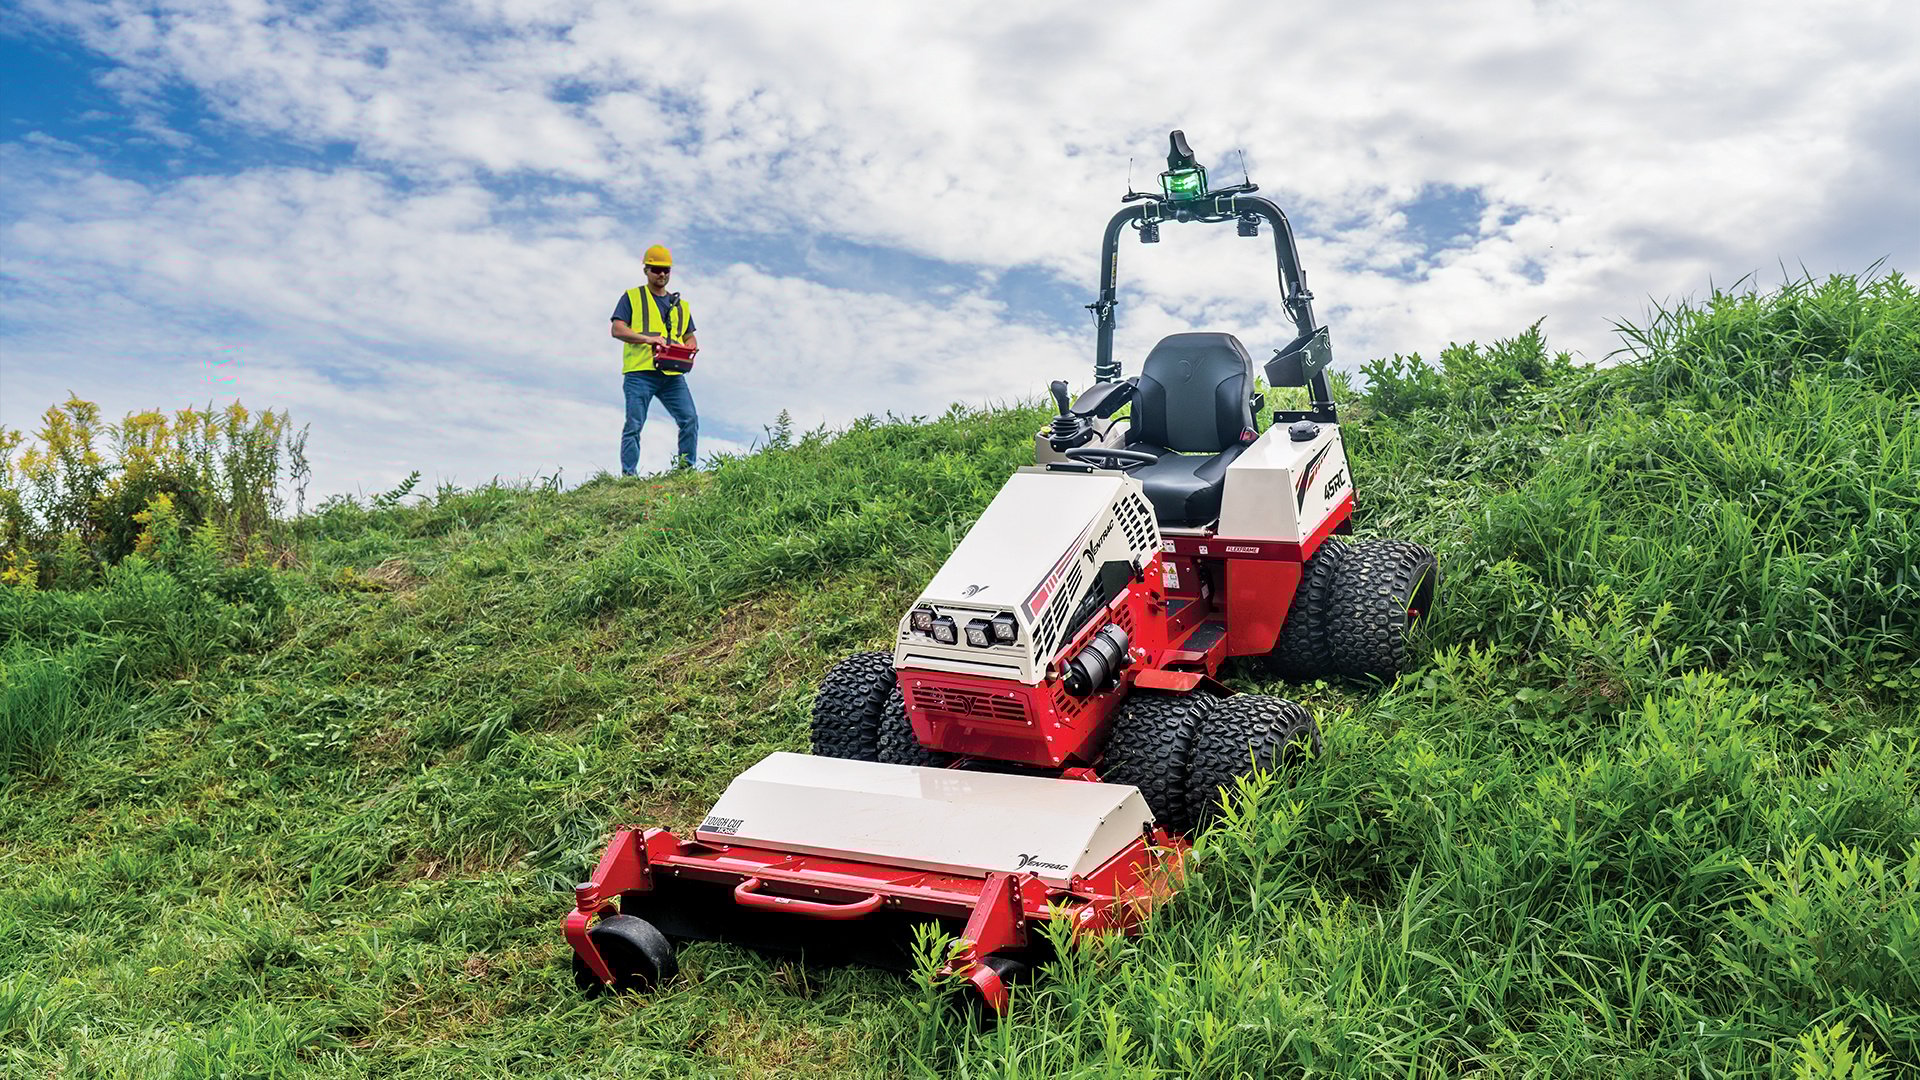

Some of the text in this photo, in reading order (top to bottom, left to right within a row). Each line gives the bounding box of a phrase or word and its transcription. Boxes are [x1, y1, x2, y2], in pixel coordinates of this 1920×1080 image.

[1324, 468, 1346, 501] 45RC
[1083, 519, 1114, 568] VENTRAC
[704, 816, 744, 829] TOUGH CUT
[1016, 853, 1069, 871] VENTRAC
